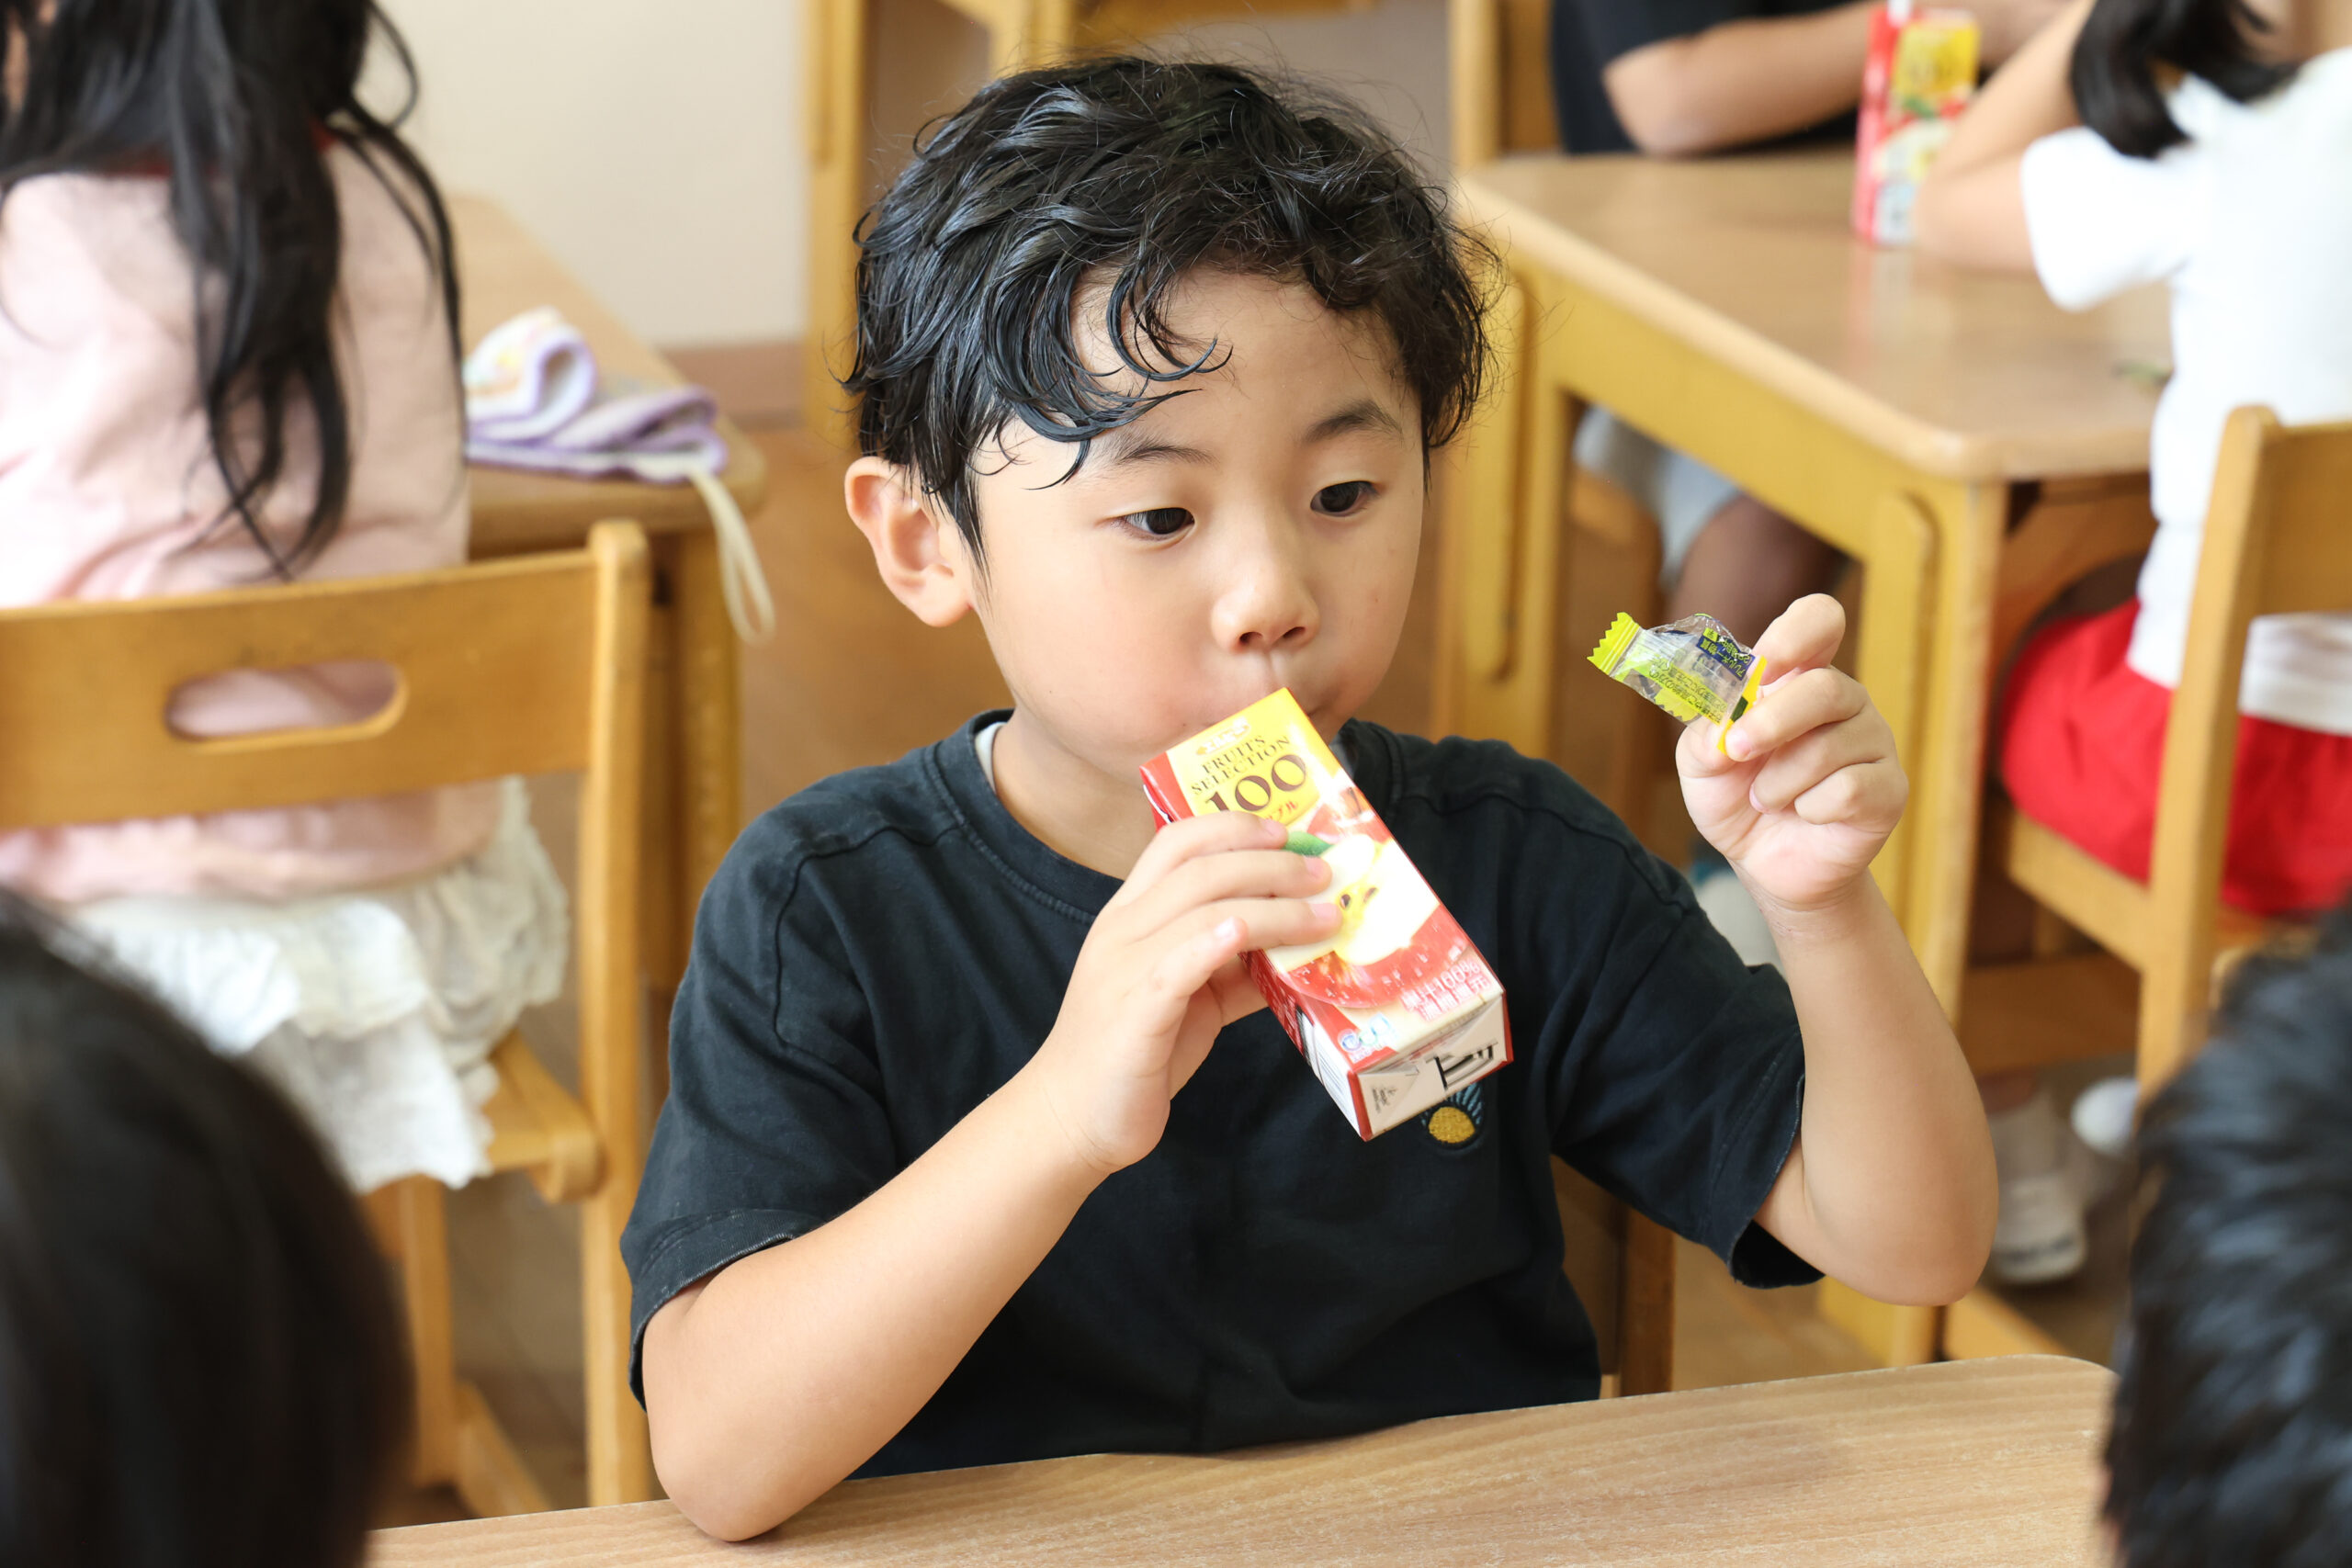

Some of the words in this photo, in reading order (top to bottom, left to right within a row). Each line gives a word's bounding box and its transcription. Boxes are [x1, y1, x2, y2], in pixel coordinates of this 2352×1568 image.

[1191, 736, 1290, 795] SELECTION
[1202, 734, 1265, 773] FRUITS
[1204, 753, 1306, 812] 100
